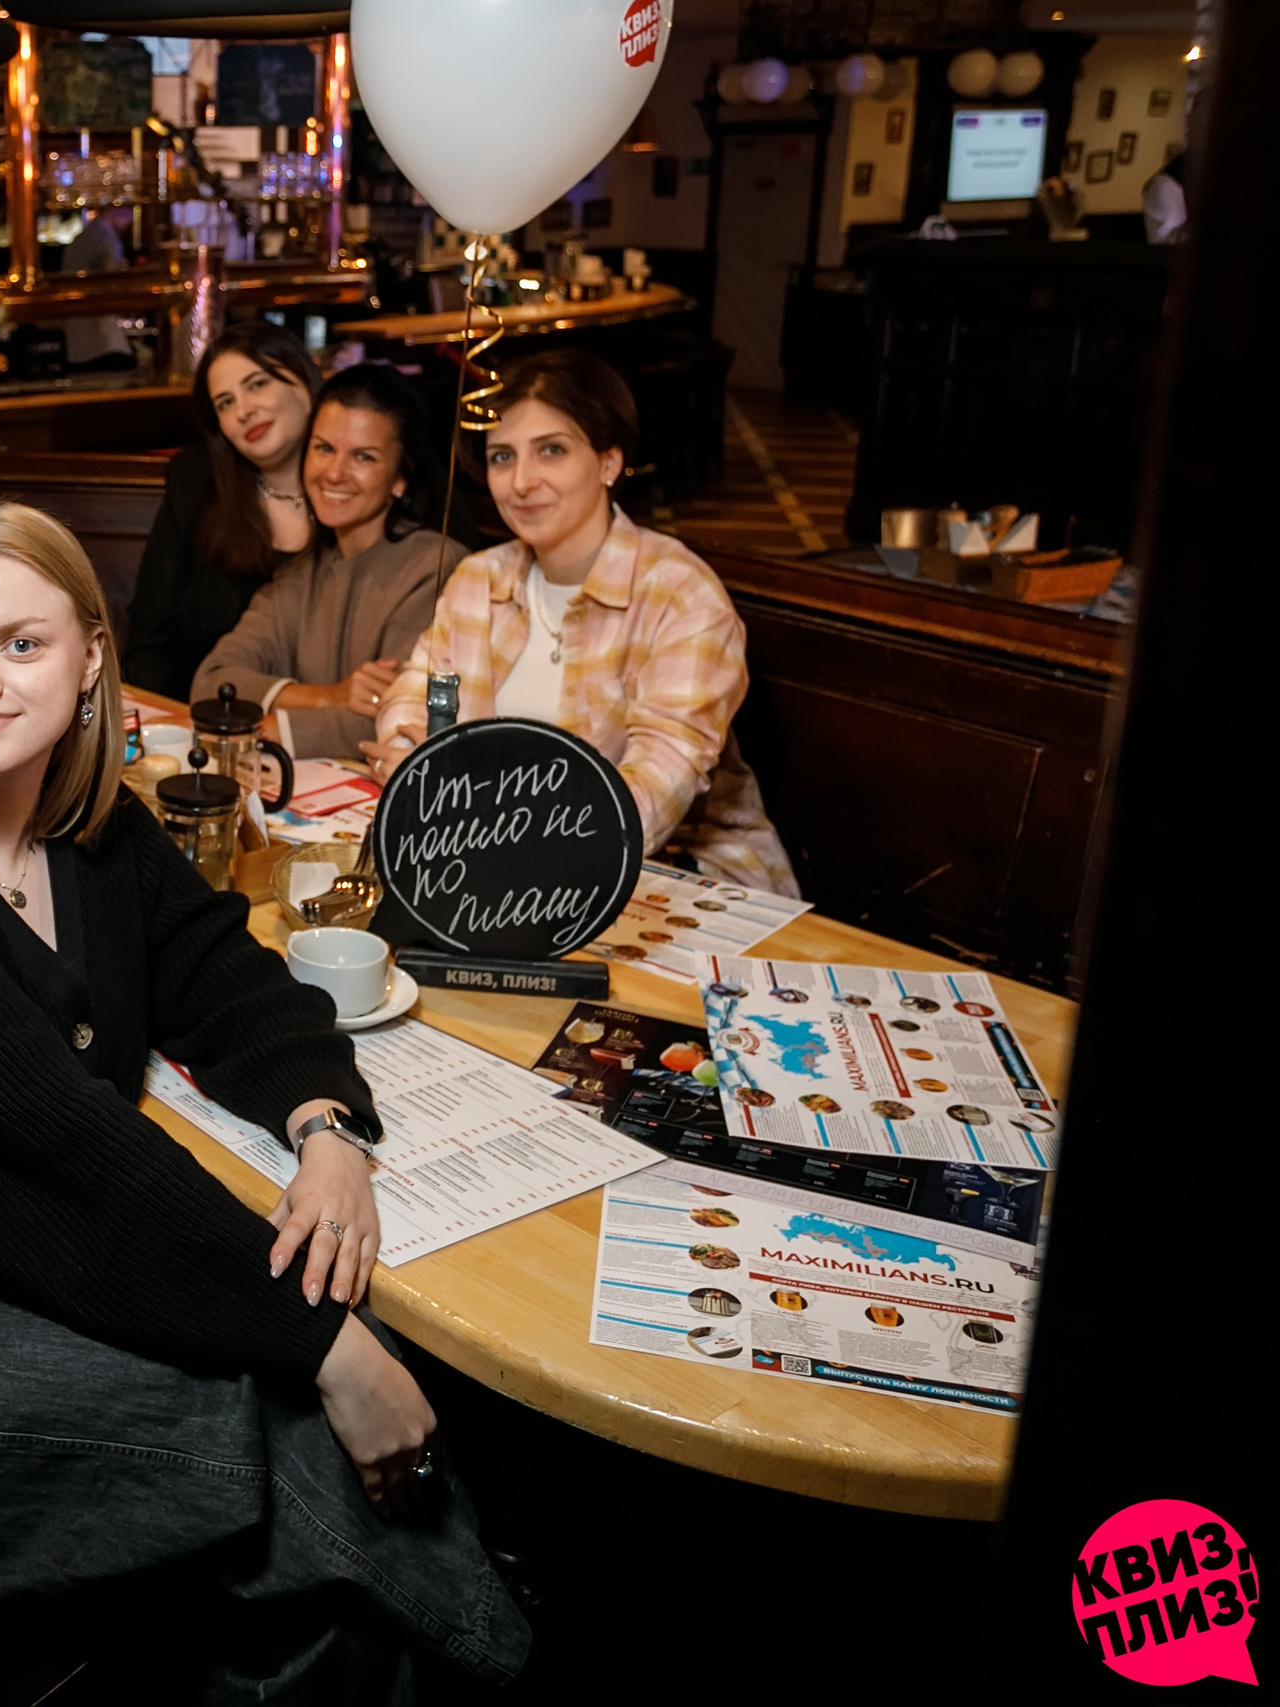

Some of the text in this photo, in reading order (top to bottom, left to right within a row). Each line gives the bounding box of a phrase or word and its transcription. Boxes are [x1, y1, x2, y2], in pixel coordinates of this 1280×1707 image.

[394, 804, 598, 872] пошло не
[413, 858, 466, 907] по
[445, 968, 557, 992] КВИЗ, ПЛИЗ!
[827, 1011, 869, 1092] MAXIMILIANS.RU
[707, 1173, 785, 1199] АЛКОГОЛЯ
[790, 1193, 850, 1215] ВРЕДИТ
[854, 1205, 924, 1231] ВАШЕМУ
[926, 1221, 1023, 1256] ЗДОРОВЬЮ
[761, 1247, 994, 1294] MAXIMILIANS.RU
[772, 1277, 797, 1287] СОРТА
[824, 1286, 863, 1297] КОТОРЫЕ
[864, 1292, 901, 1302] ВАРЯТСЯ
[909, 1300, 940, 1310] НАШЕМ
[941, 1305, 990, 1317] РЕСТОРАНЕ
[823, 1367, 1010, 1405] ВЫПУСТИТЬ КАРТУ ЛОЯЛЬНОСТИ
